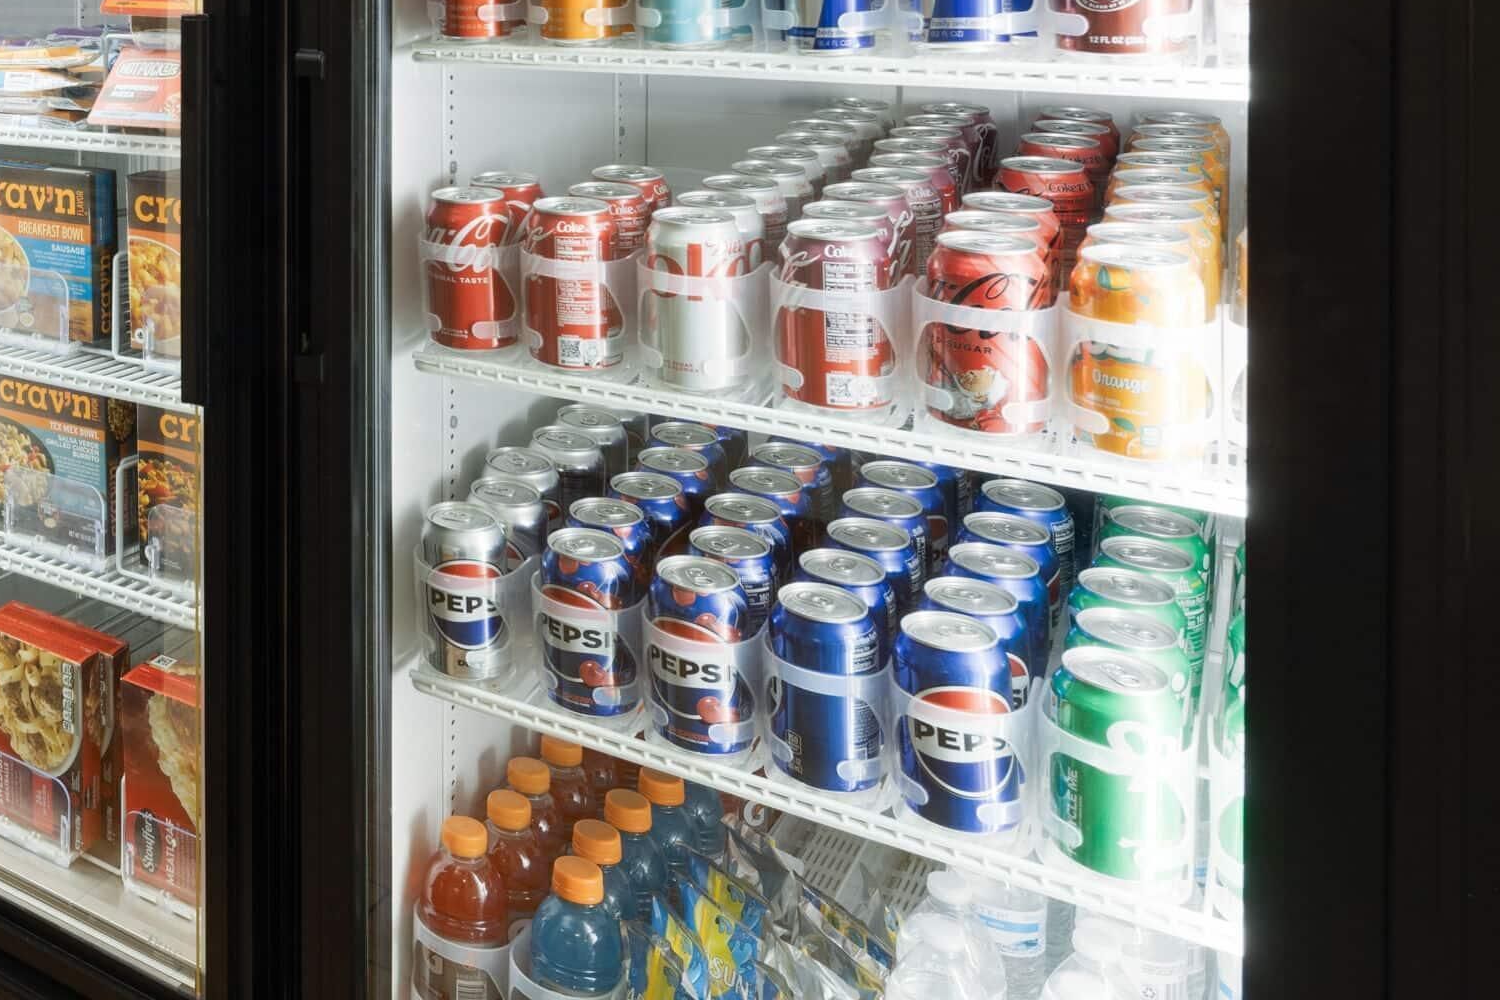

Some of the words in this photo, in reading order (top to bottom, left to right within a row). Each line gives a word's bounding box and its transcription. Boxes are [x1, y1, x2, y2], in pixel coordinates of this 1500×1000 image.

[1089, 36, 1099, 45] 12
[1100, 36, 1110, 45] FL
[1112, 36, 1124, 45] OZ
[18, 220, 60, 238] BREAKFAST
[62, 225, 84, 241] BOWL
[556, 221, 585, 234] Coke
[51, 243, 85, 256] SAUSAGE
[824, 244, 852, 259] Cok
[460, 276, 489, 284] TASTE
[947, 340, 993, 355] SUGAR
[431, 591, 498, 614] PEPS
[650, 643, 736, 682] PEPSI
[913, 721, 1012, 753] PEPS
